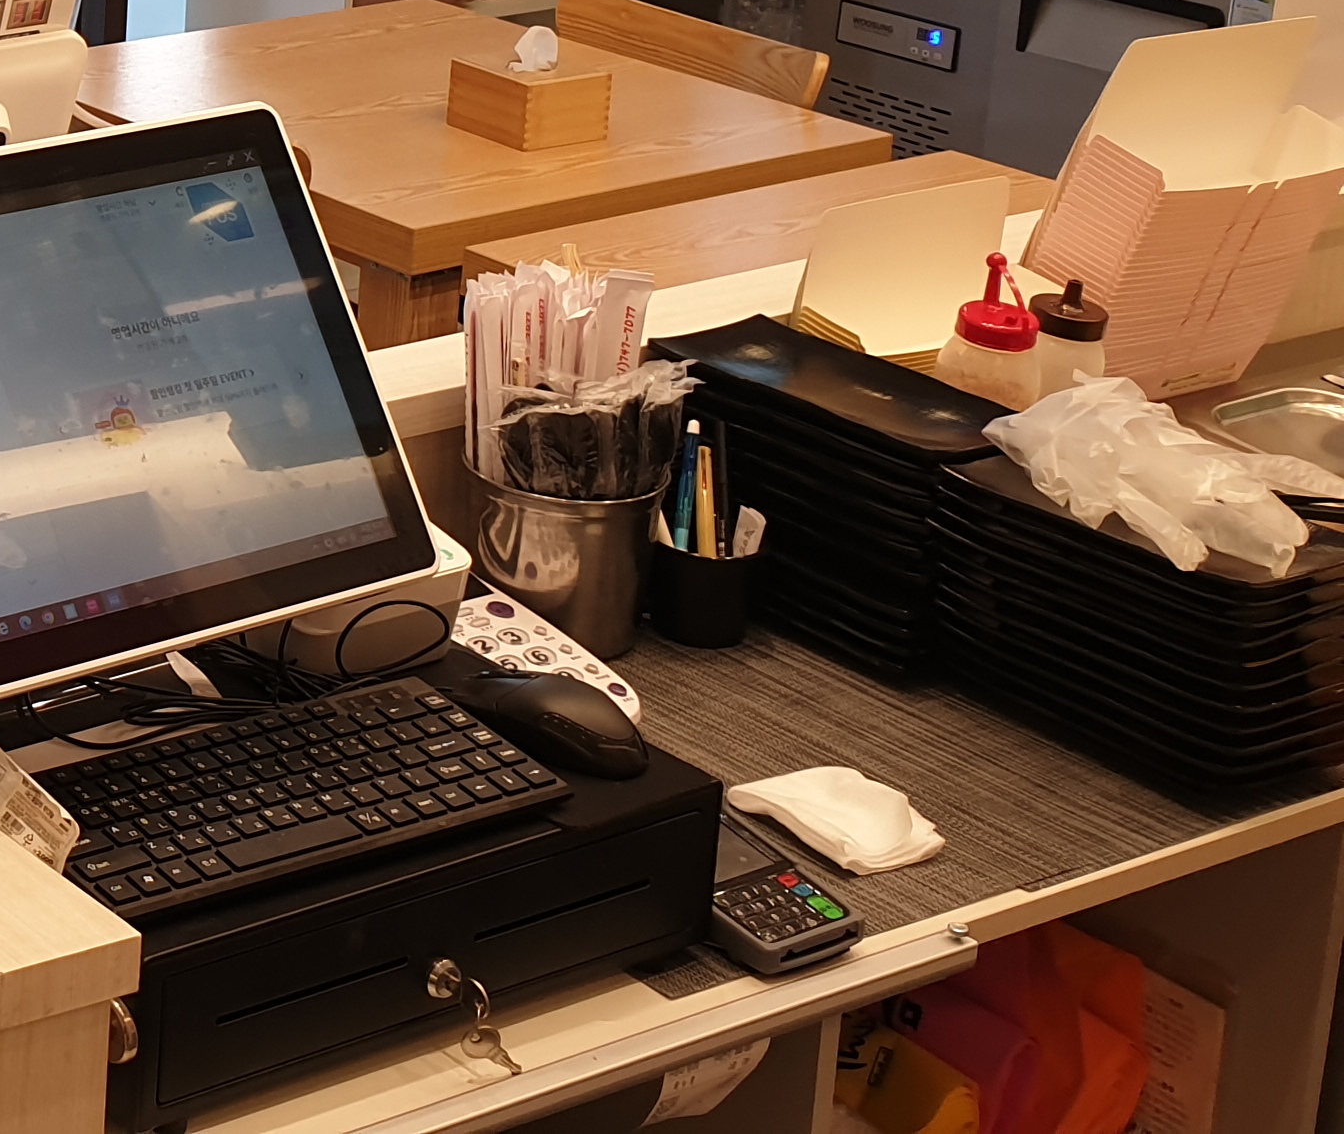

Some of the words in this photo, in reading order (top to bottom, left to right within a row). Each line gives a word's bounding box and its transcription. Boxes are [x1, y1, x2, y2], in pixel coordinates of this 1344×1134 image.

[852, 16, 894, 35] WOOSUNG
[220, 369, 248, 385] EVENT
[472, 639, 494, 654] 2
